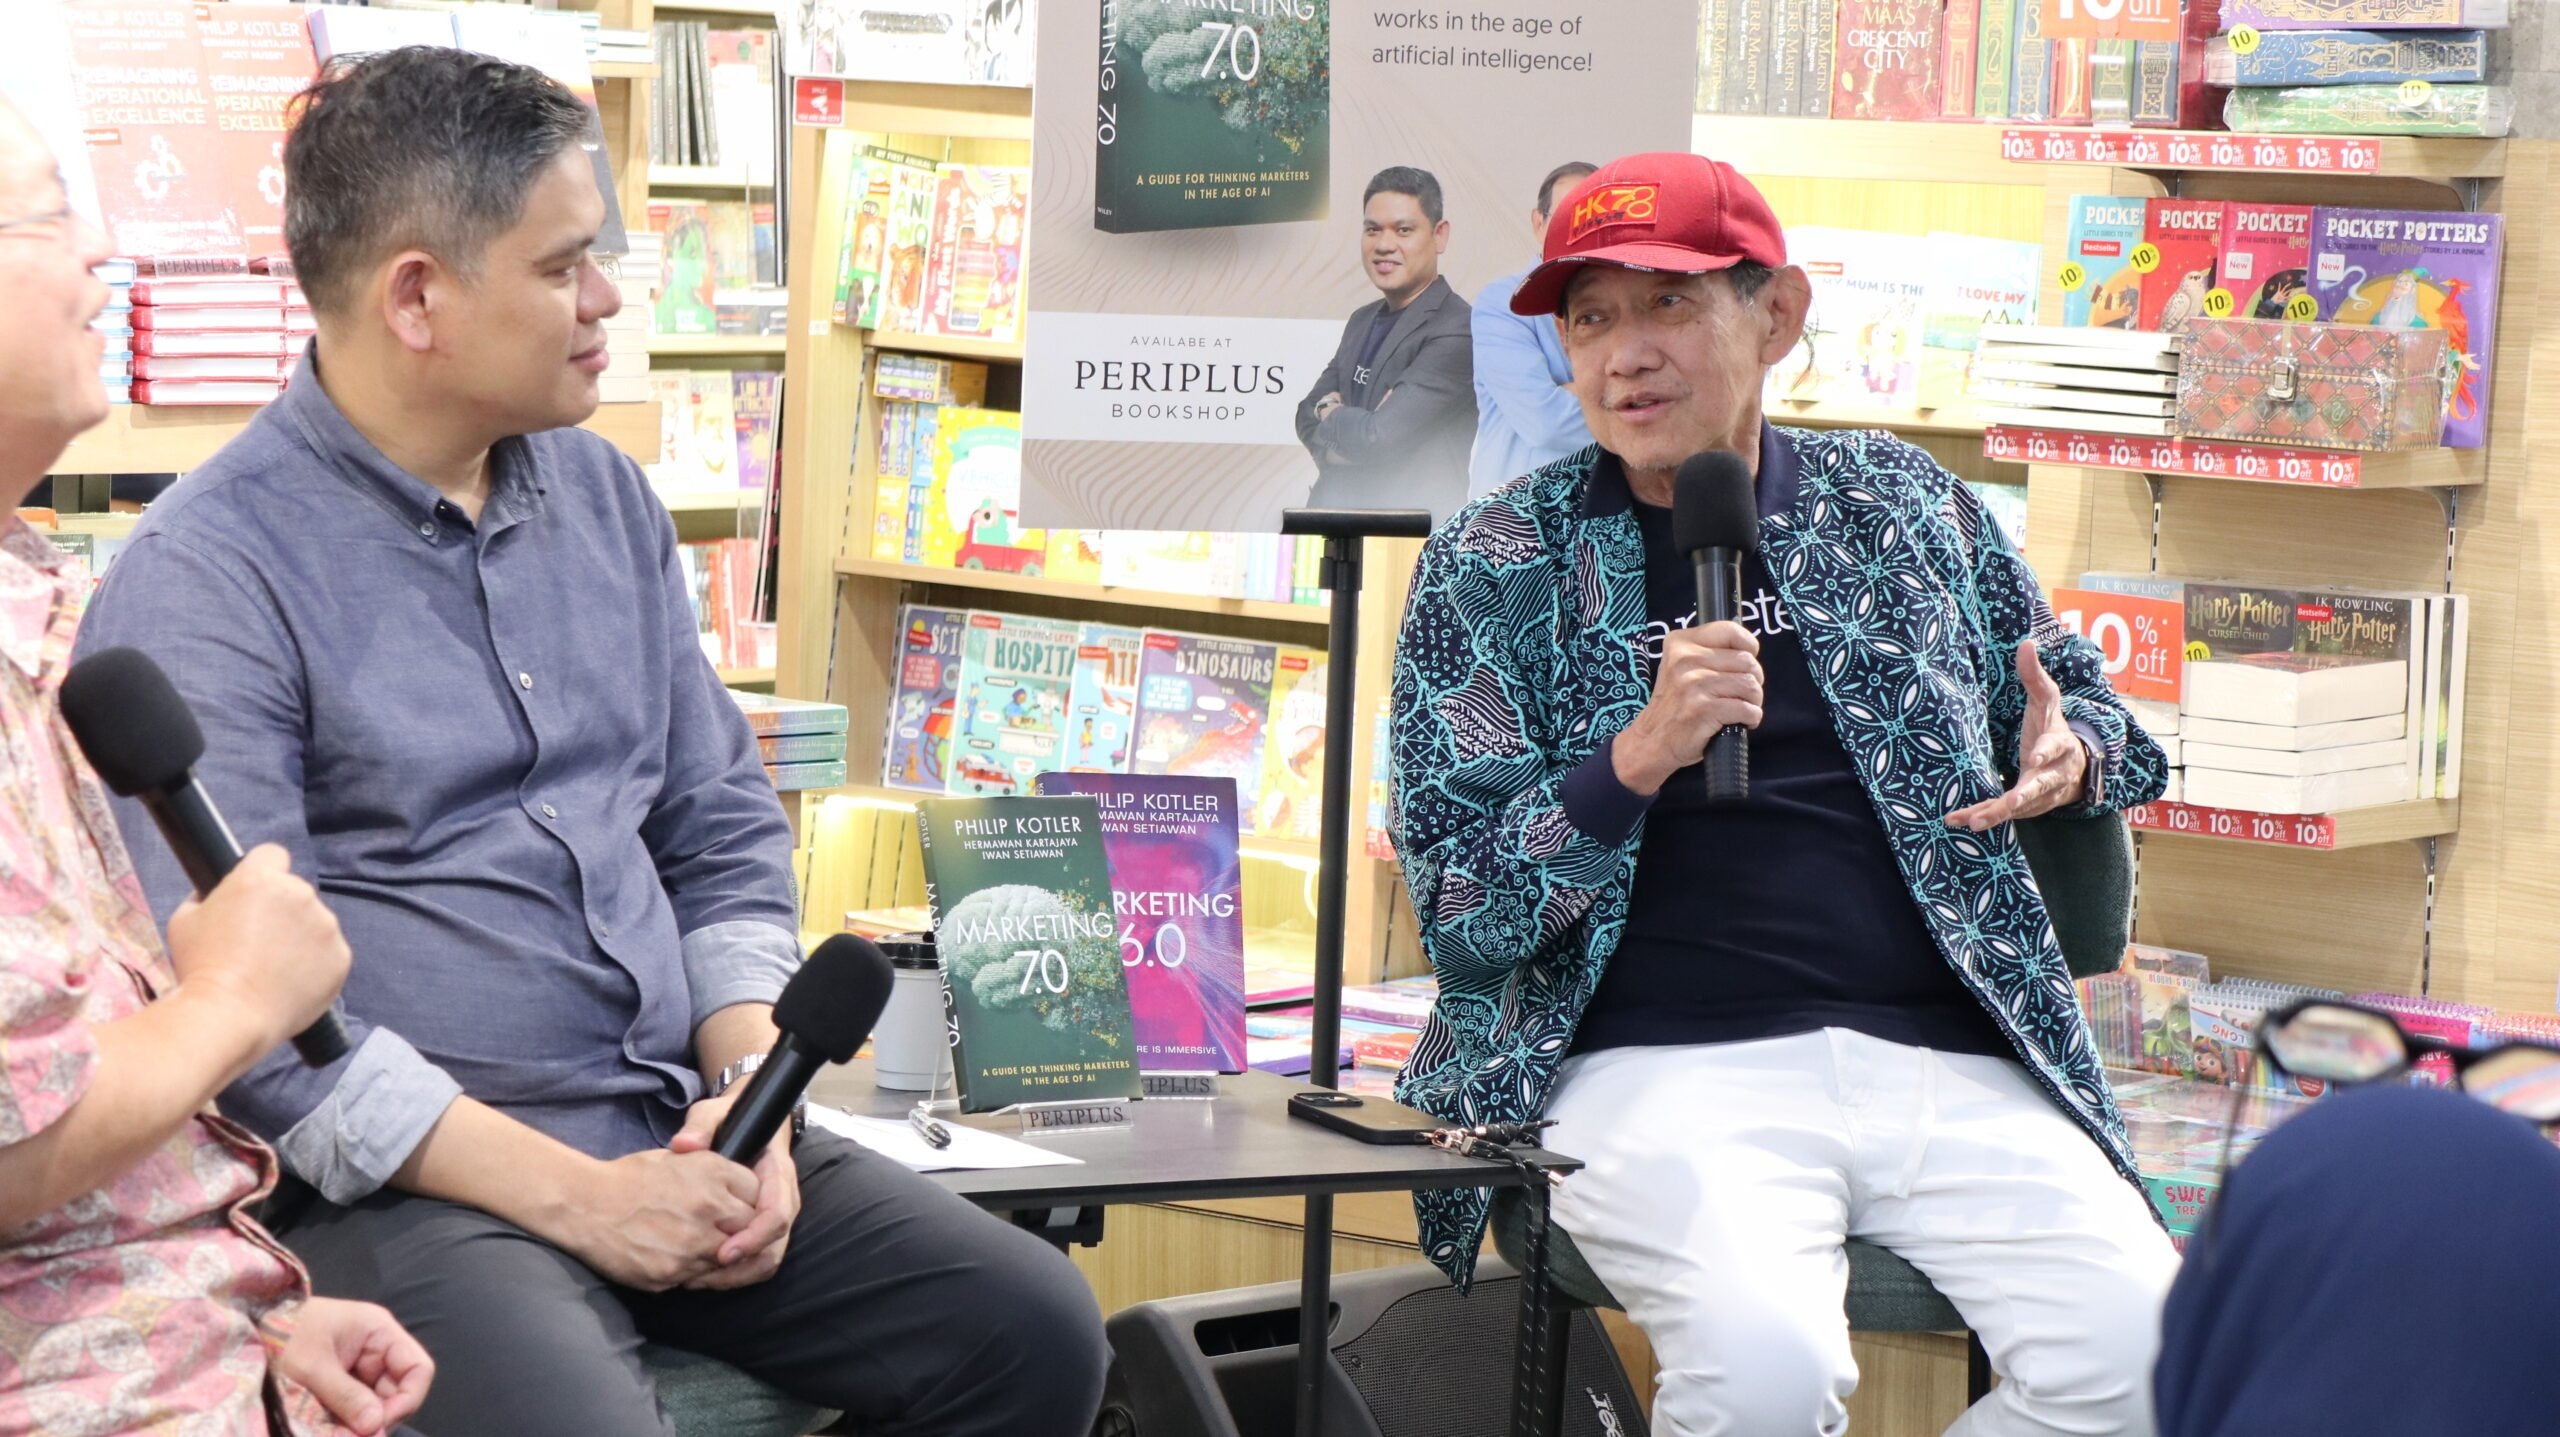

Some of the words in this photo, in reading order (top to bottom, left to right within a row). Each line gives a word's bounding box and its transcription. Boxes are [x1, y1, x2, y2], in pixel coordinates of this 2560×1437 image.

[1374, 9, 1438, 30] works
[1446, 11, 1463, 31] in
[1471, 12, 1504, 32] the
[1512, 16, 1552, 38] age
[1560, 16, 1582, 35] of
[1863, 6, 1916, 26] MAAS
[243, 21, 300, 37] KOTLER
[1847, 30, 1929, 49] CRESCENT
[1200, 21, 1260, 81] 7.0
[1372, 45, 1454, 66] artificial
[1462, 48, 1592, 74] intelligence!
[1863, 49, 1909, 70] CITY
[93, 108, 207, 124] EXCELLENCE
[1136, 175, 1144, 185] A
[1148, 175, 1180, 184] GUIDE
[1186, 174, 1204, 184] FOR
[1209, 172, 1256, 183] THINKING
[1260, 171, 1310, 182] MARKETERS
[1184, 190, 1196, 200] IN
[1200, 189, 1217, 199] THE
[1222, 188, 1241, 198] AGE
[1245, 188, 1257, 198] OF
[1261, 187, 1270, 197] AI
[2236, 211, 2308, 233] POCKET
[2326, 218, 2399, 240] POCKET
[2403, 222, 2489, 243] POTTERS
[2083, 244, 2118, 252] Bestseller
[2229, 261, 2248, 269] New
[2321, 263, 2340, 271] New
[1846, 280, 1878, 292] MUM
[1883, 282, 1895, 294] IS
[1966, 288, 2000, 302] LOVE
[2004, 293, 2026, 305] MY
[1130, 336, 1206, 347] AVAILABE
[1214, 338, 1232, 348] AT
[1074, 360, 1285, 395] PERIPLUS
[1111, 404, 1245, 420] BOOKSHOP
[2113, 581, 2170, 596] ROWLING
[2188, 594, 2240, 630] Harry
[2240, 593, 2291, 633] Potter
[2298, 608, 2329, 618] Bestseller
[2334, 598, 2393, 613] ROWLING
[2207, 629, 2240, 639] CURSED
[2242, 631, 2269, 641] CHILD
[2352, 613, 2396, 646] Potter
[994, 637, 1075, 676] HOSPITA
[2135, 648, 2167, 675] off
[1176, 651, 1272, 683] DINOSAURS
[1144, 794, 1218, 811] KOTLER
[954, 818, 1008, 836] PHILIP
[1016, 816, 1082, 834] KOTLER
[1150, 814, 1219, 823] KARTAJAYA
[1134, 824, 1196, 834] SETIAWAN
[964, 840, 1023, 850] HERMAWAN
[1026, 837, 1078, 848] KARTAJAYA
[983, 850, 1010, 860] IWAN
[1014, 849, 1063, 859] SETIAWAN
[1112, 891, 1234, 917] RKETING
[957, 912, 1114, 944] MARKETING
[1118, 922, 1186, 968] 6.0
[1014, 950, 1069, 995] 7.0
[1165, 1046, 1217, 1055] IMMERSIVE
[983, 1069, 988, 1077] A
[992, 1067, 1018, 1076] GUIDE
[1021, 1066, 1037, 1074] FOR
[1040, 1063, 1080, 1073] THINKING
[1084, 1061, 1130, 1071] MARKETERS
[1022, 1077, 1032, 1086] IN
[1034, 1077, 1050, 1085] THE
[1053, 1075, 1070, 1084] AGE
[1073, 1075, 1083, 1083] OF
[1086, 1074, 1096, 1082] AI
[1148, 1078, 1211, 1093] IPLUS
[1029, 1106, 1124, 1128] PERIPLUS
[2165, 1186, 2206, 1204] SWE
[2175, 1206, 2205, 1216] TREA
